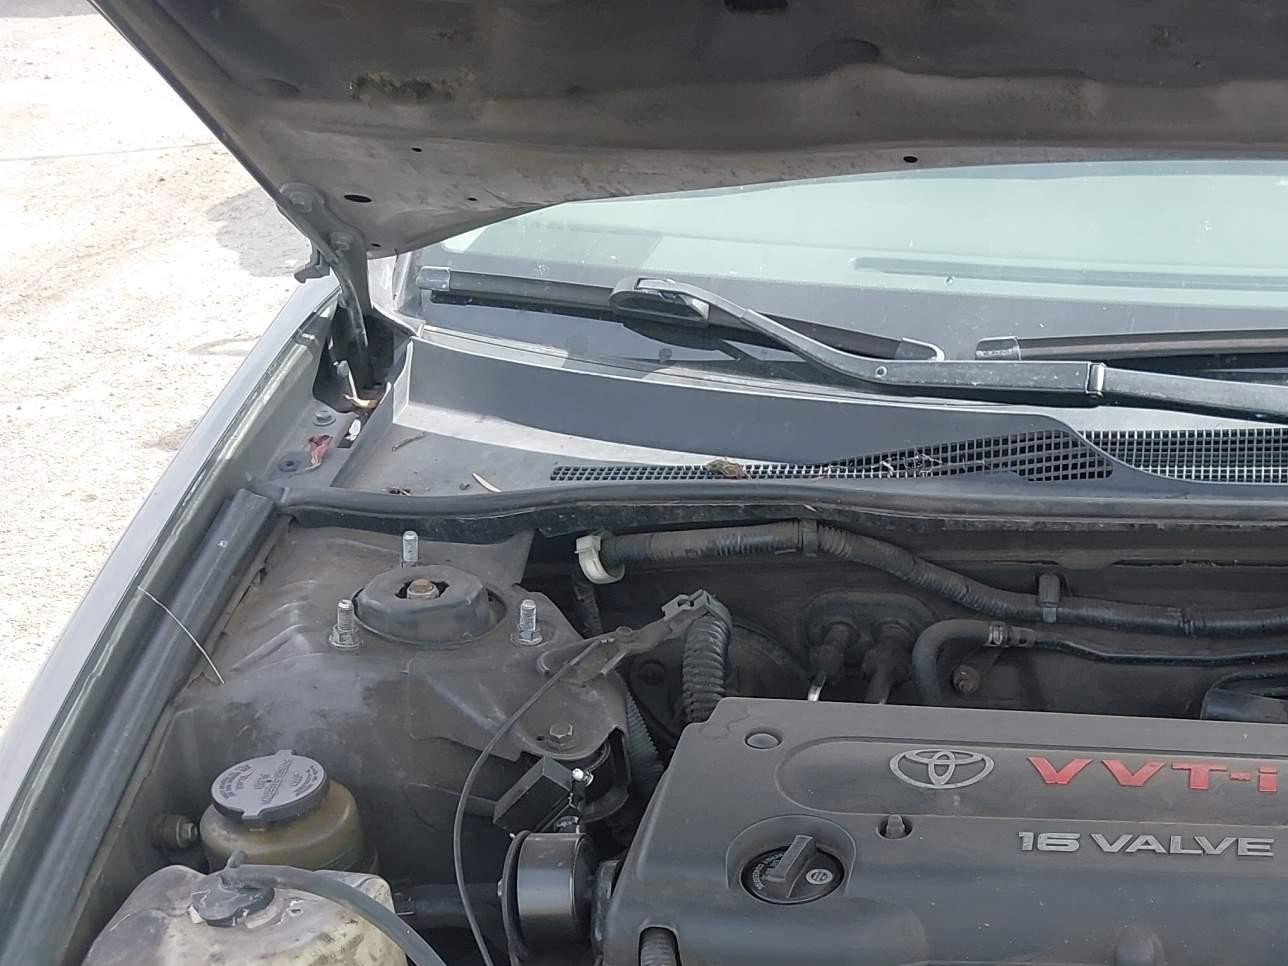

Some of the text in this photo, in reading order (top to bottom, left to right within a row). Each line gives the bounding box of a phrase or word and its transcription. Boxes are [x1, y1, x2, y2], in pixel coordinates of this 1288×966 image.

[1026, 755, 1279, 792] VVT-i
[1017, 831, 1274, 857] 16 VALVE
